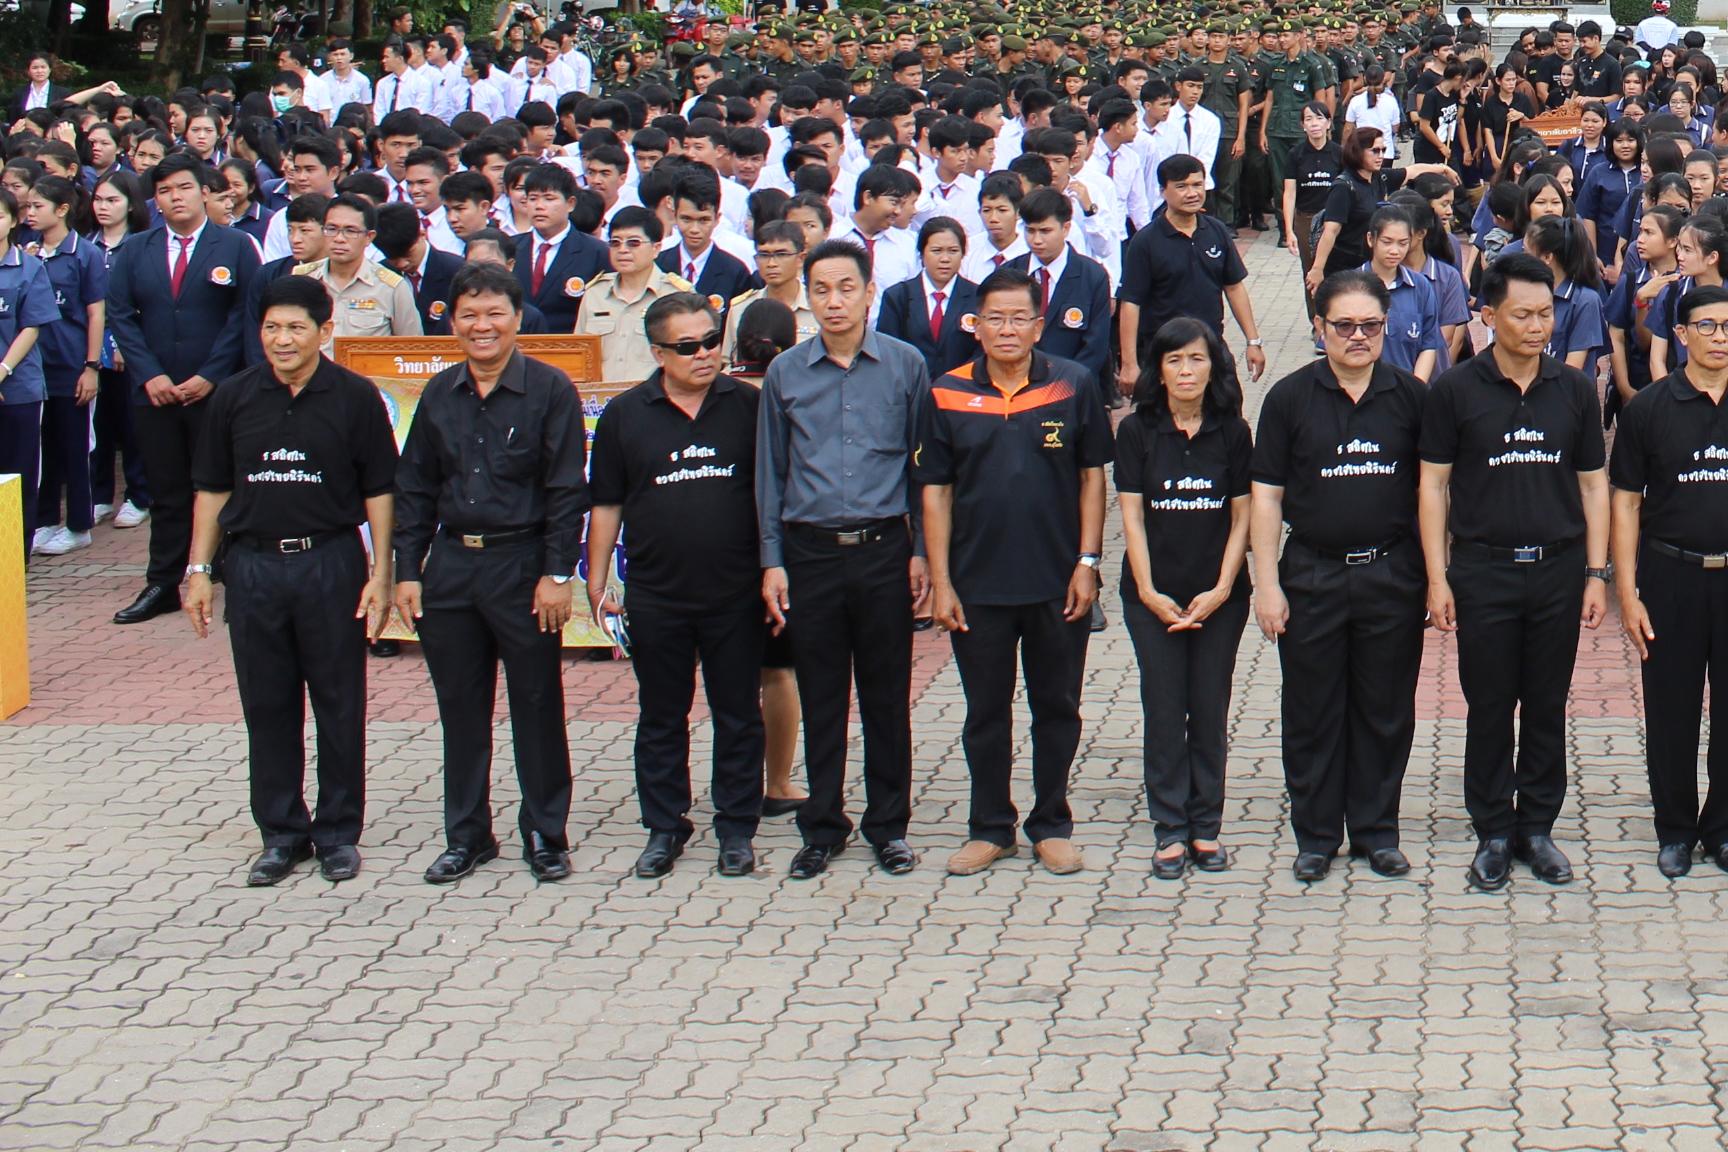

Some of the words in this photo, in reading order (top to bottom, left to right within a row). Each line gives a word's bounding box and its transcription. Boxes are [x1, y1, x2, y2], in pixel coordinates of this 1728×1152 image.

[1504, 433, 1511, 443] ธ
[1514, 427, 1544, 442] สถิตใน
[670, 451, 678, 461] ธ
[682, 445, 716, 459] สถิตใน
[1337, 445, 1343, 454] ธ
[1347, 439, 1379, 453] สถิตใน
[263, 452, 269, 461] ธ
[1694, 451, 1699, 461] ธ
[1164, 480, 1172, 490] ธ
[1177, 476, 1212, 490] สถิตใน
